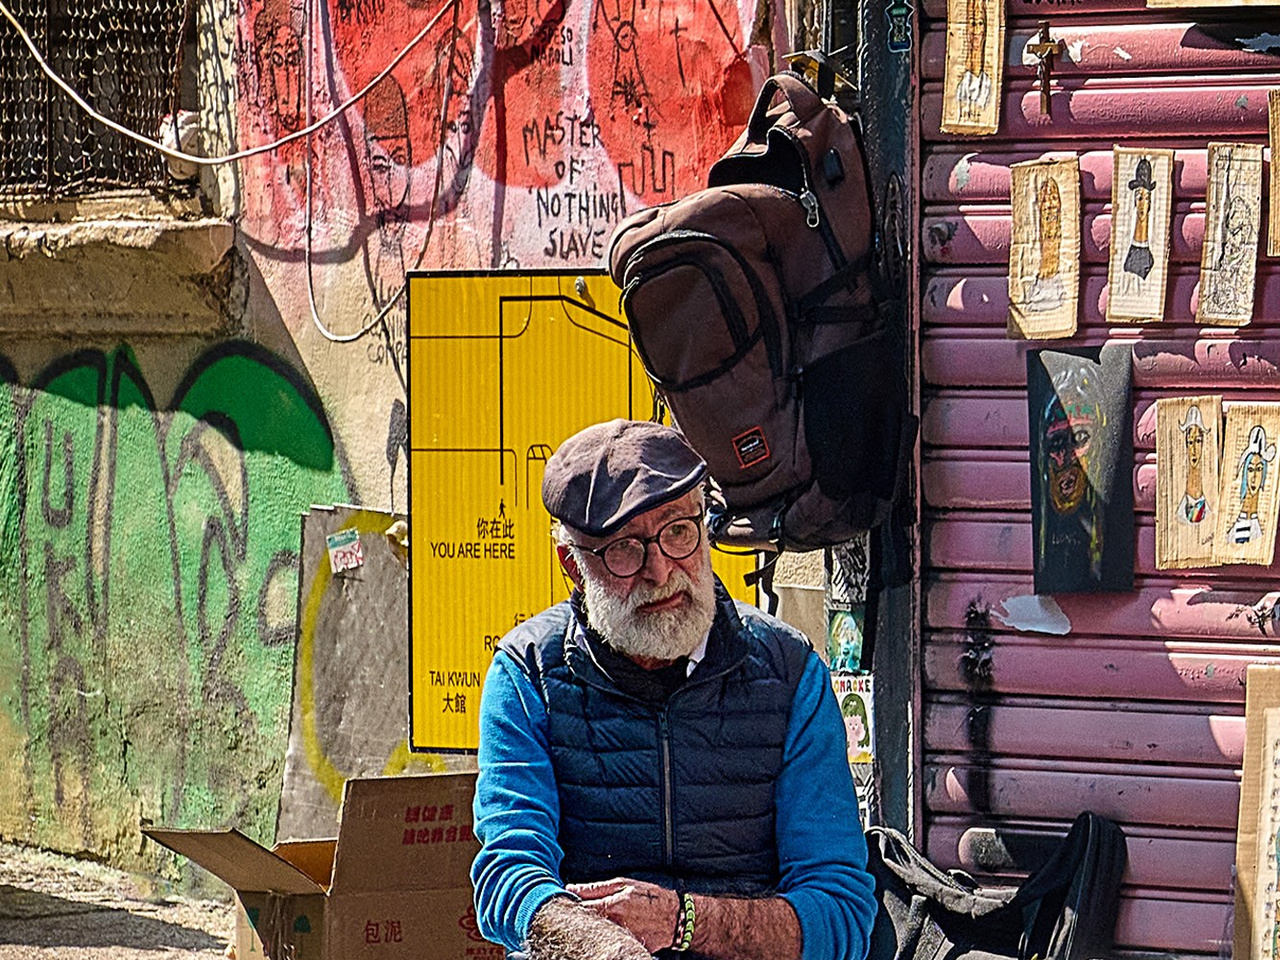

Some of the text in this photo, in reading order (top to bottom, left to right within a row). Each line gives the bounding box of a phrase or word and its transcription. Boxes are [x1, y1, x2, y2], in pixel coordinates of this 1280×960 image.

[522, 112, 605, 166] MASTER
[555, 156, 584, 185] OF
[536, 182, 618, 228] NOTHING
[543, 226, 606, 260] SLAVE
[477, 518, 515, 539] 你在此
[430, 542, 516, 559] YOU ARE HERE
[429, 671, 481, 688] TAI KWUN
[442, 693, 467, 714] 大館
[363, 919, 404, 944] 包泥
